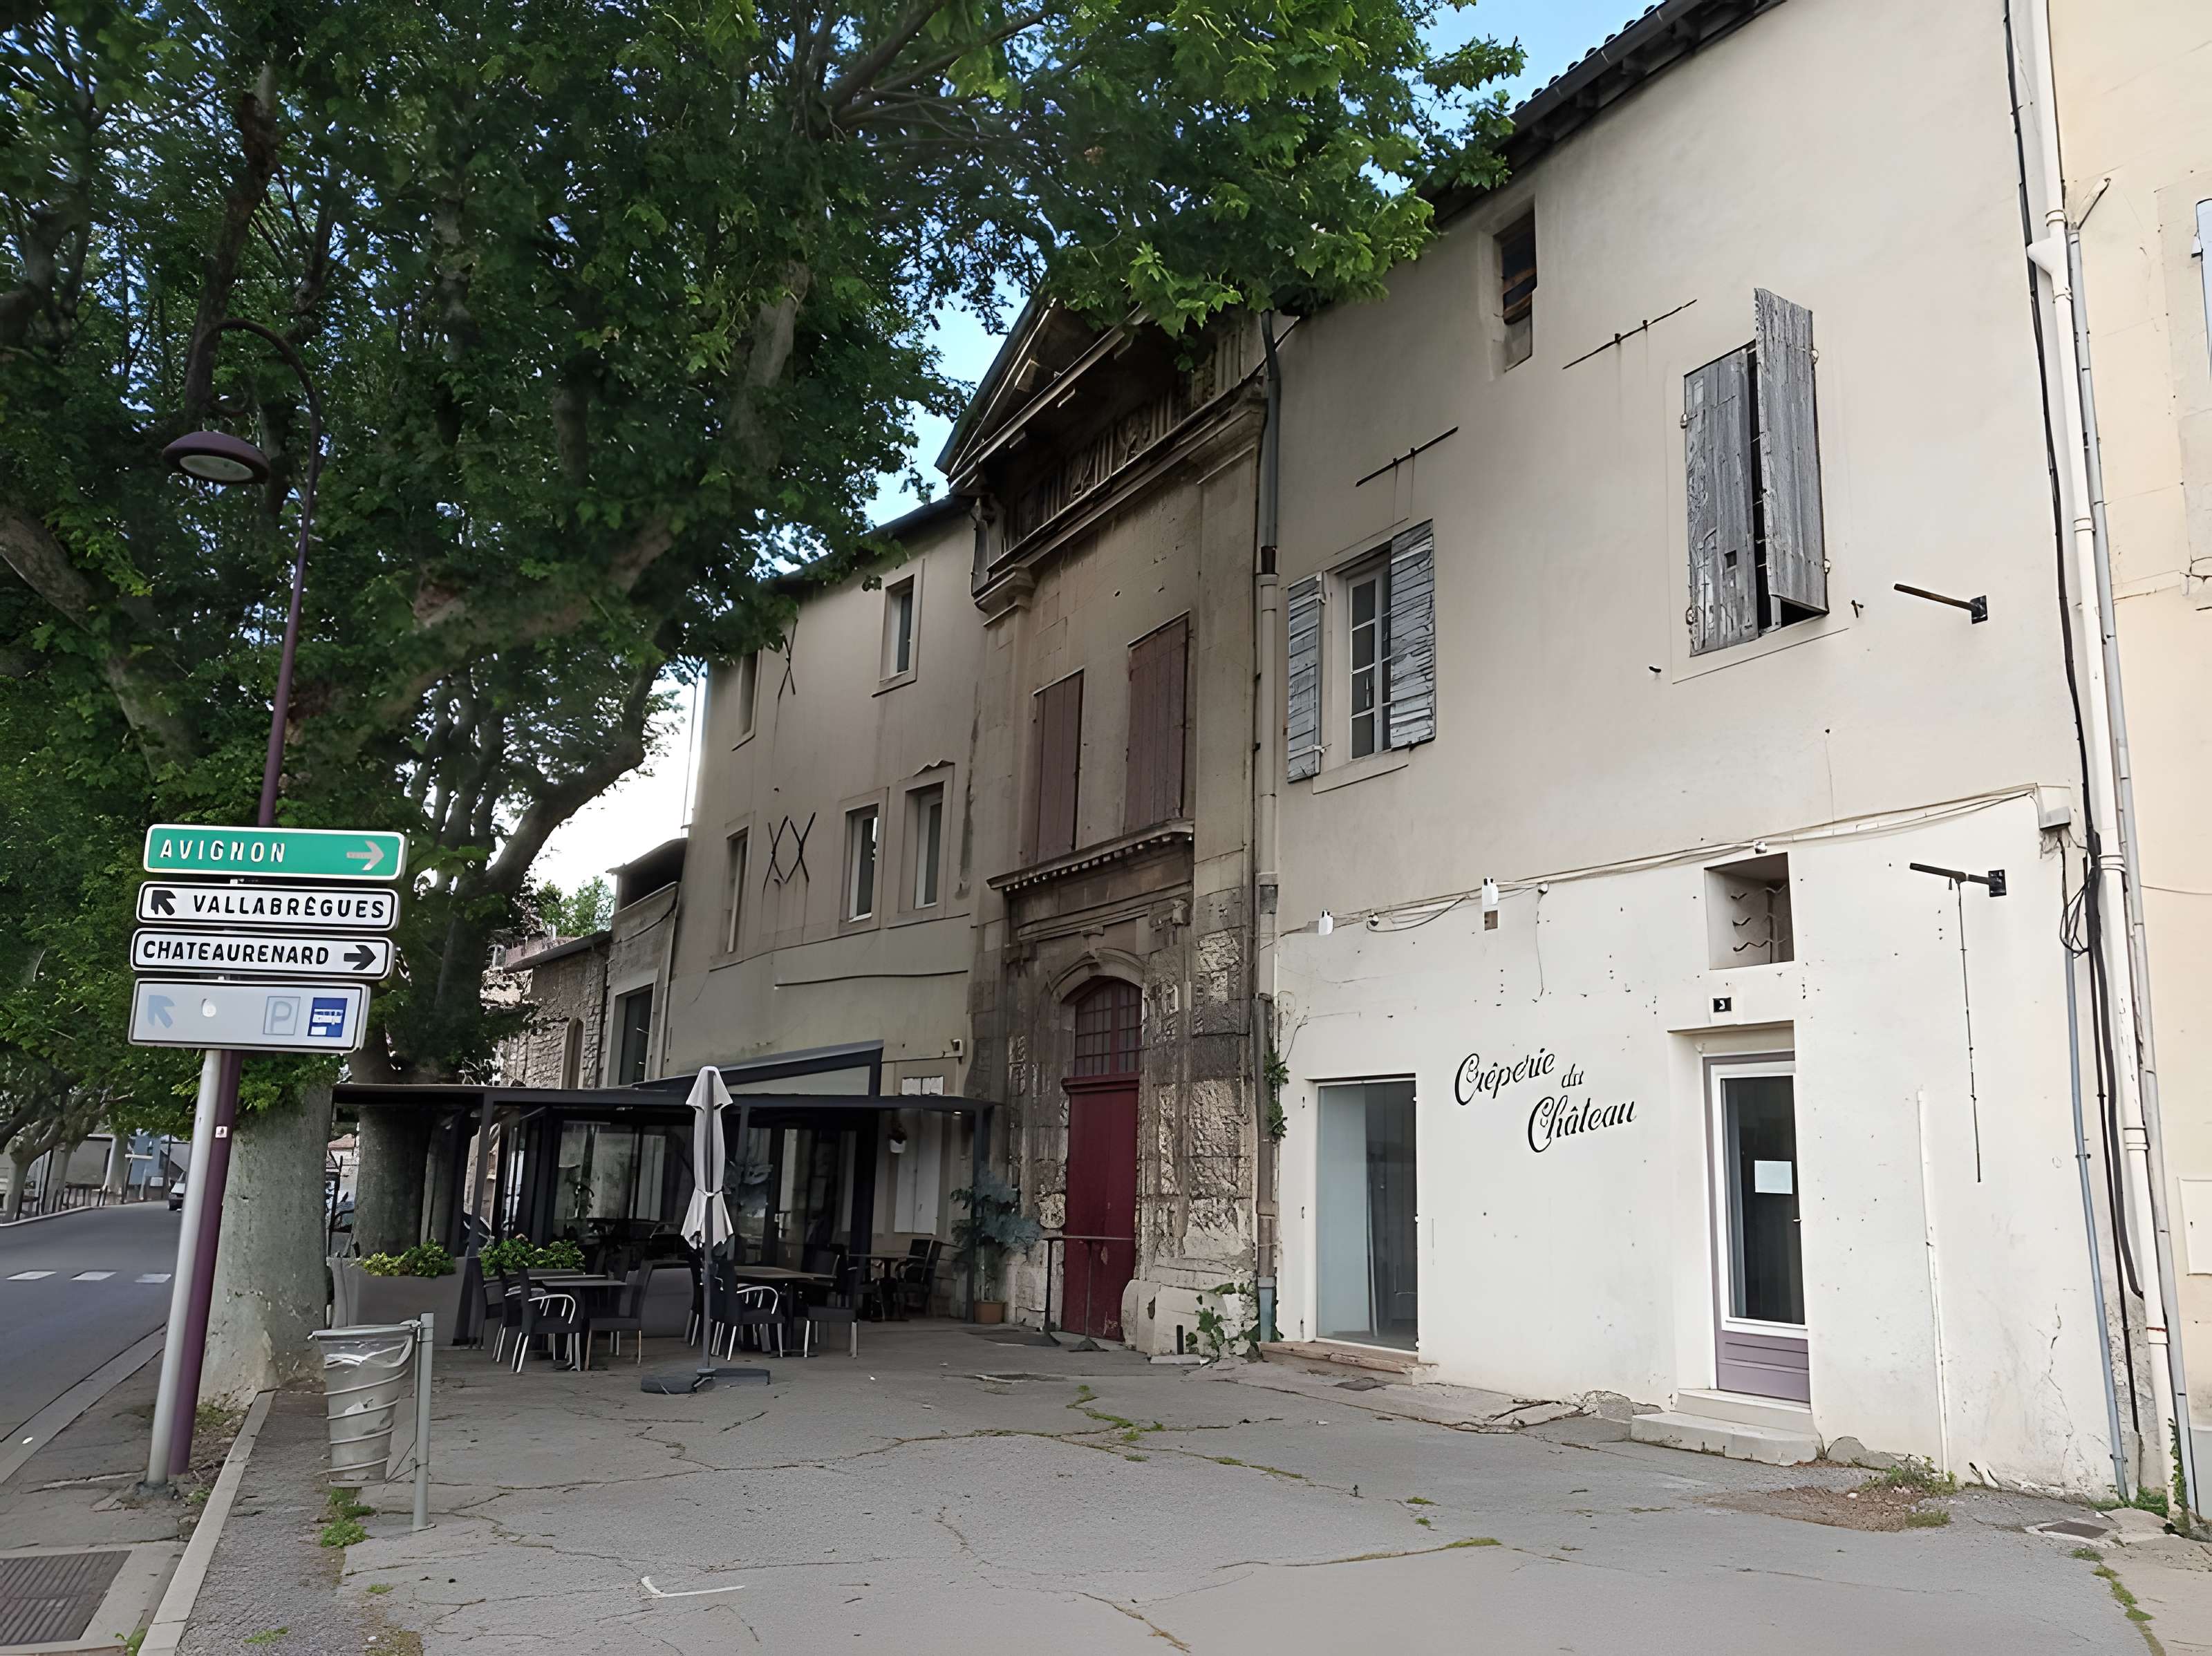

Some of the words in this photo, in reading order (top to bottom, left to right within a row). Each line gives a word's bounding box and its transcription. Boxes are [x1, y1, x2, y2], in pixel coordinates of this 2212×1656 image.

[160, 839, 285, 863] AVIGNON
[143, 940, 329, 965] CHATEAURENARD
[270, 1001, 292, 1033] P
[1454, 1048, 1555, 1106] Crêperie
[1562, 1063, 1584, 1088] du
[1528, 1095, 1637, 1153] Château
